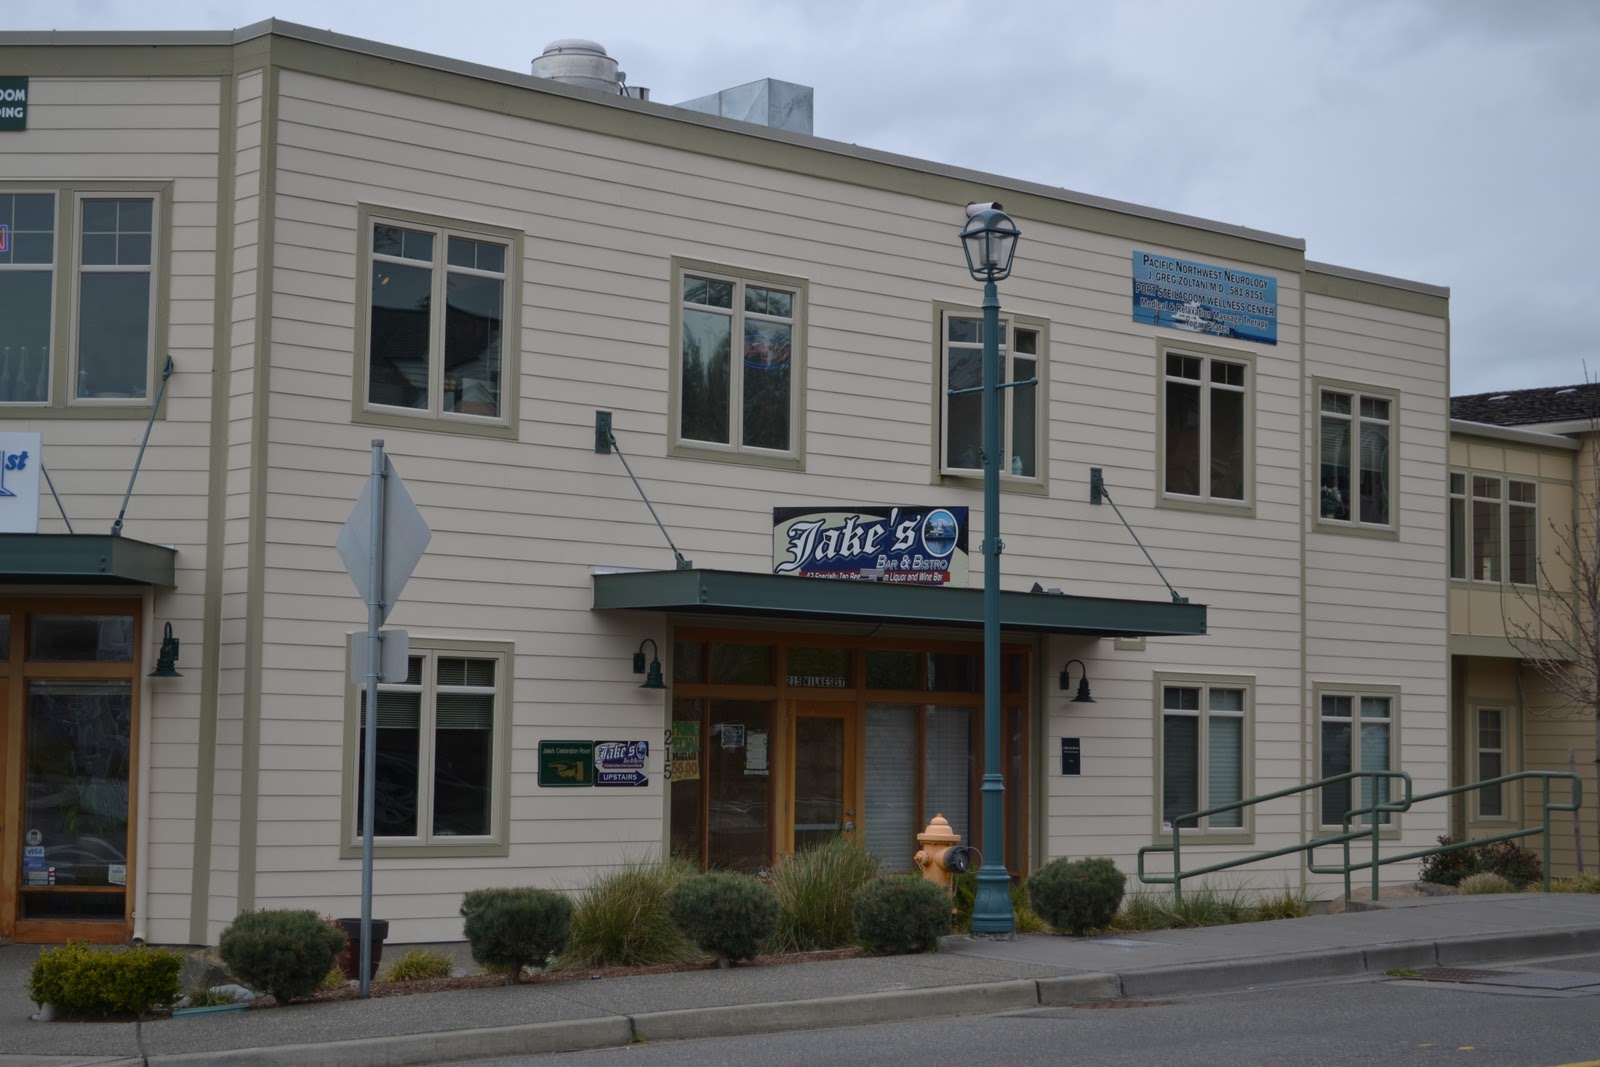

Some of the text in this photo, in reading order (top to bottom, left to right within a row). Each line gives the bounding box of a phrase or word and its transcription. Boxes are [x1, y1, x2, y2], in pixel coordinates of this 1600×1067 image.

[0, 107, 24, 118] ING
[1143, 254, 1268, 289] PACIFIC NORTHWEST NEUROLOGY
[1148, 272, 1264, 300] J. GREG ZOLTANI M.D. 581-8151
[1136, 283, 1275, 317] PORT STEILACOOM WELLNESS CENTER
[1140, 298, 1268, 330] Medical & Relaxation Massage Therapy
[775, 507, 922, 574] Jake's
[876, 555, 949, 570] BAR & BISTRO
[889, 572, 907, 583] Liquor
[907, 573, 918, 581] and
[919, 572, 932, 581] Wine
[933, 572, 943, 581] Bar
[834, 677, 846, 687] ST
[597, 741, 637, 764] Jake's
